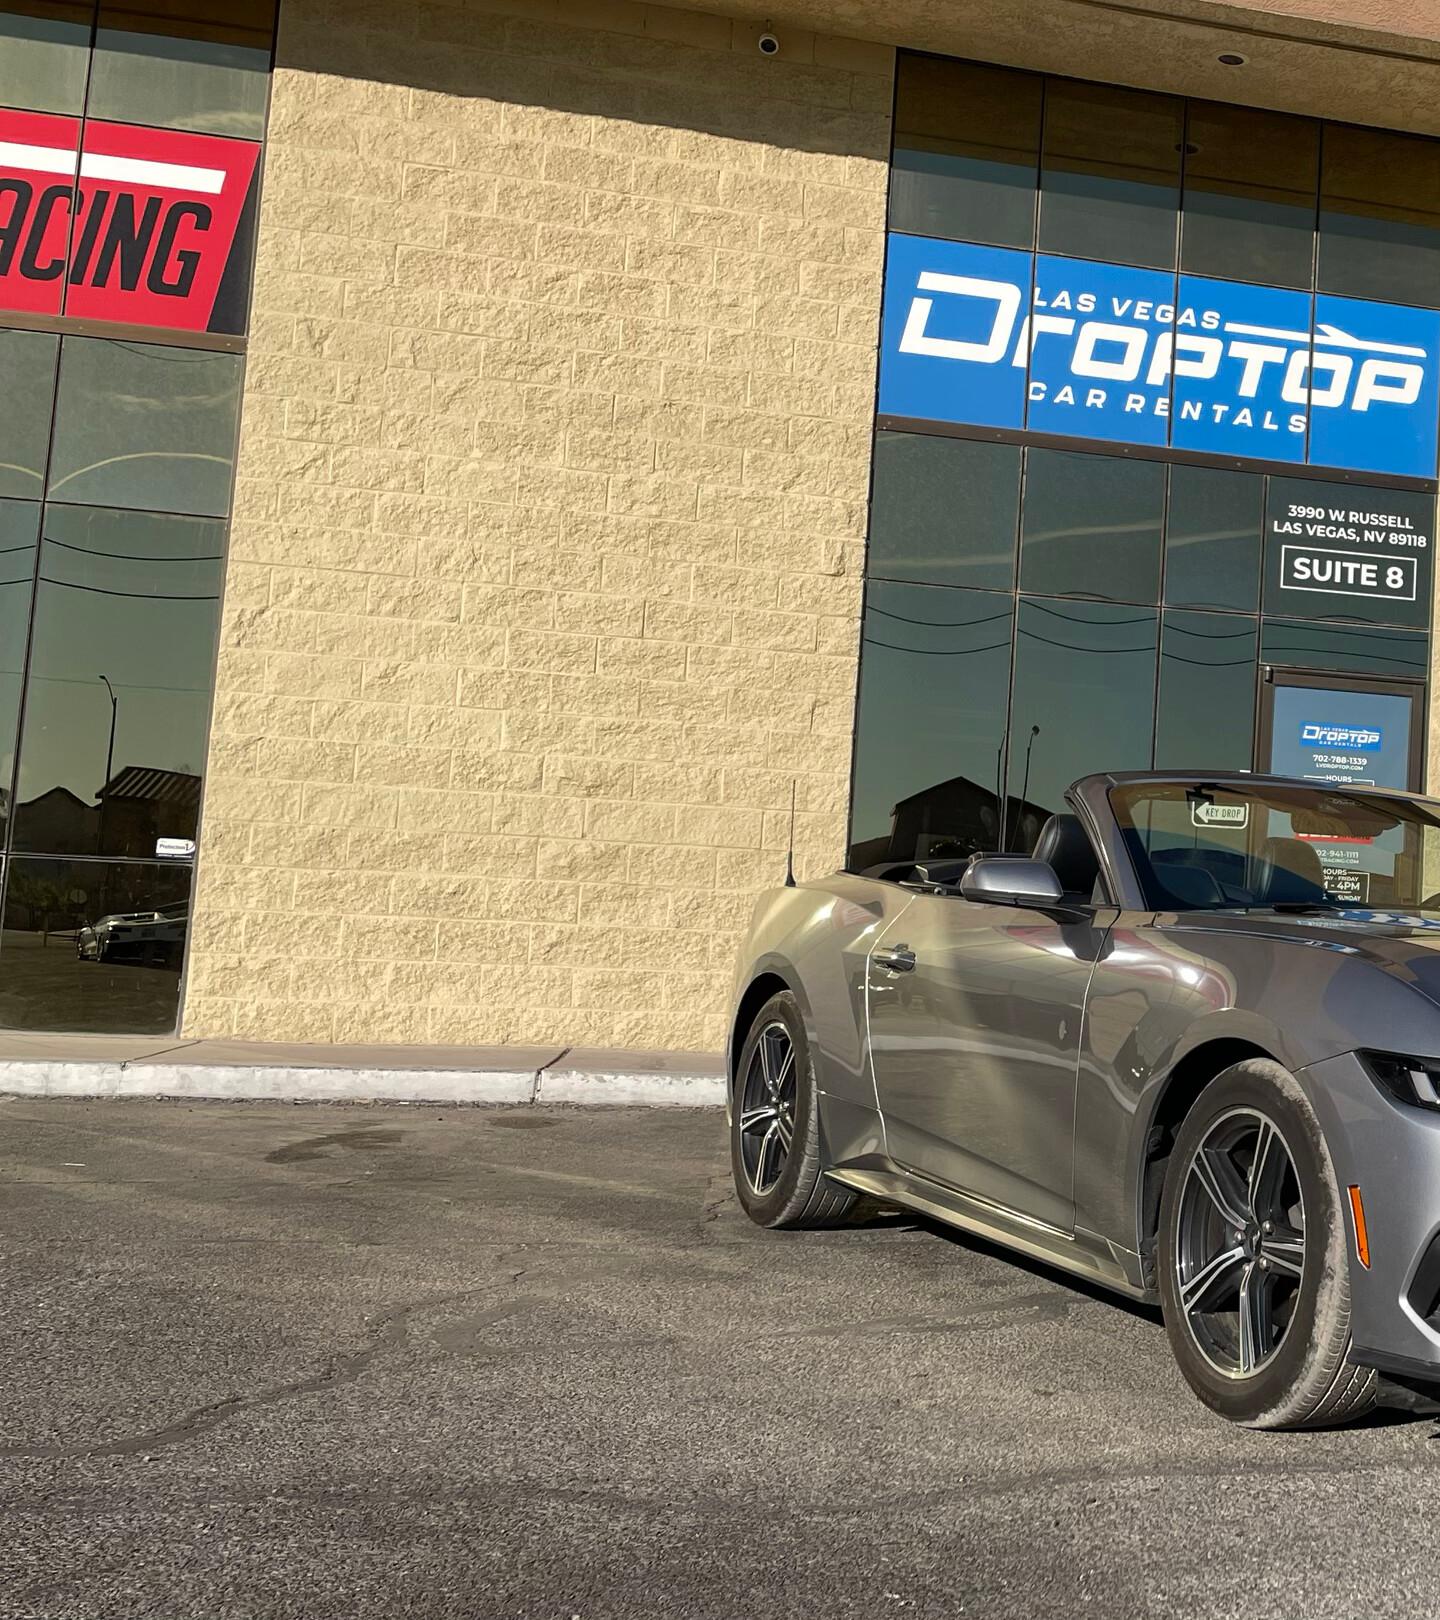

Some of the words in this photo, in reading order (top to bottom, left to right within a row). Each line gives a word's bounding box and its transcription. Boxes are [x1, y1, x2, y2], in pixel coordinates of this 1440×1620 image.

[1032, 286, 1097, 313] LAS
[1112, 298, 1222, 329] VEGAS
[1028, 381, 1105, 409] CAR
[1125, 394, 1308, 434] RENTALS
[1288, 504, 1325, 520] 3990
[1349, 511, 1414, 529] RUSSELL
[1273, 520, 1302, 535] LAS
[1306, 524, 1360, 543] VEGAS,
[1364, 530, 1386, 543] NV
[1388, 534, 1427, 548] 89118
[1293, 557, 1378, 587] SUITE
[1385, 566, 1404, 589] 8
[1312, 754, 1368, 766] 702-788-1339
[1325, 774, 1353, 783] HOURS
[1205, 808, 1219, 818] KEY
[1221, 809, 1242, 818] DROP
[1316, 849, 1359, 859] 02-941-1111
[1336, 881, 1361, 891] 4PM
